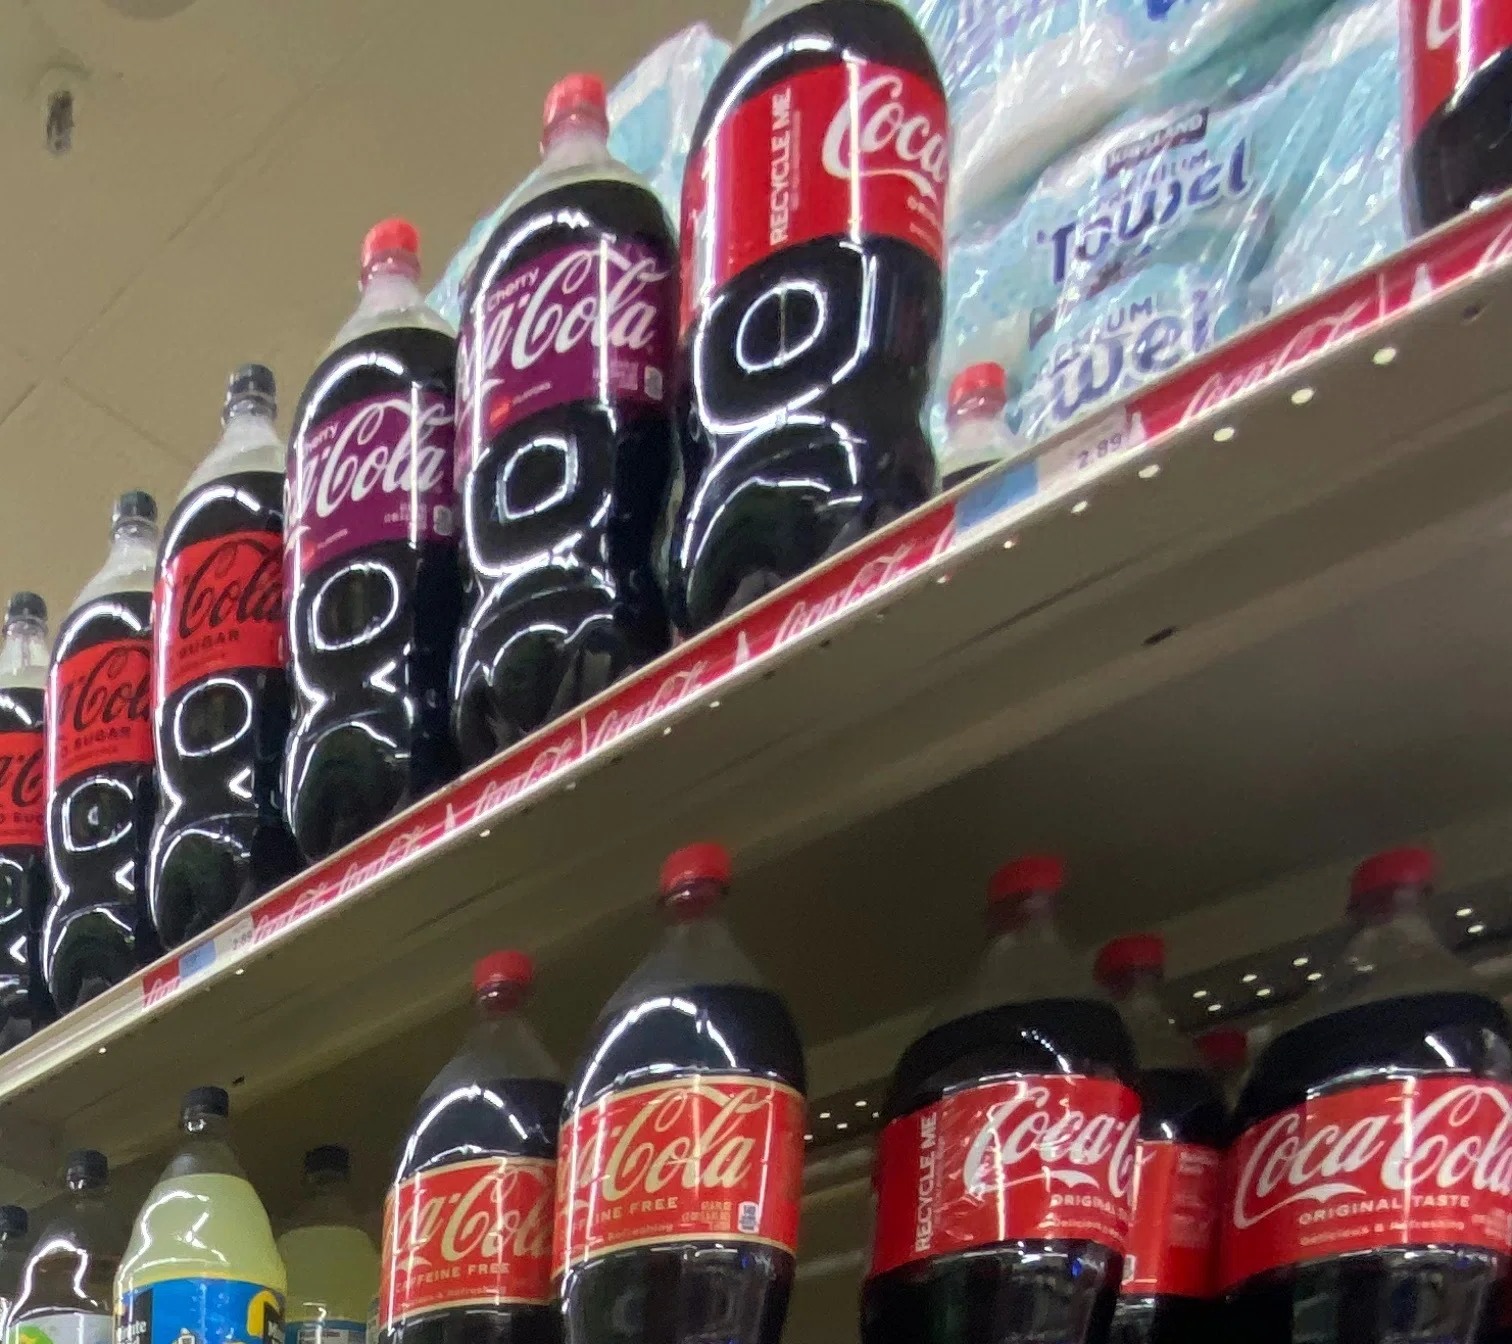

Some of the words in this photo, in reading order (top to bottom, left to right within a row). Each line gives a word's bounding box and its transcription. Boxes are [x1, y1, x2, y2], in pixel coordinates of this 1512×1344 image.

[771, 137, 790, 246] RECYCLE
[1036, 138, 1255, 286] Towel
[1076, 433, 1124, 470] 2.89
[12, 810, 45, 829] SUG
[921, 1110, 938, 1149] ME
[629, 1195, 680, 1215] FREE
[915, 1150, 936, 1253] RECYCLE
[1298, 1196, 1400, 1226] ORIGINAL
[1412, 1194, 1471, 1209] TASTE
[467, 1261, 511, 1278] FREE
